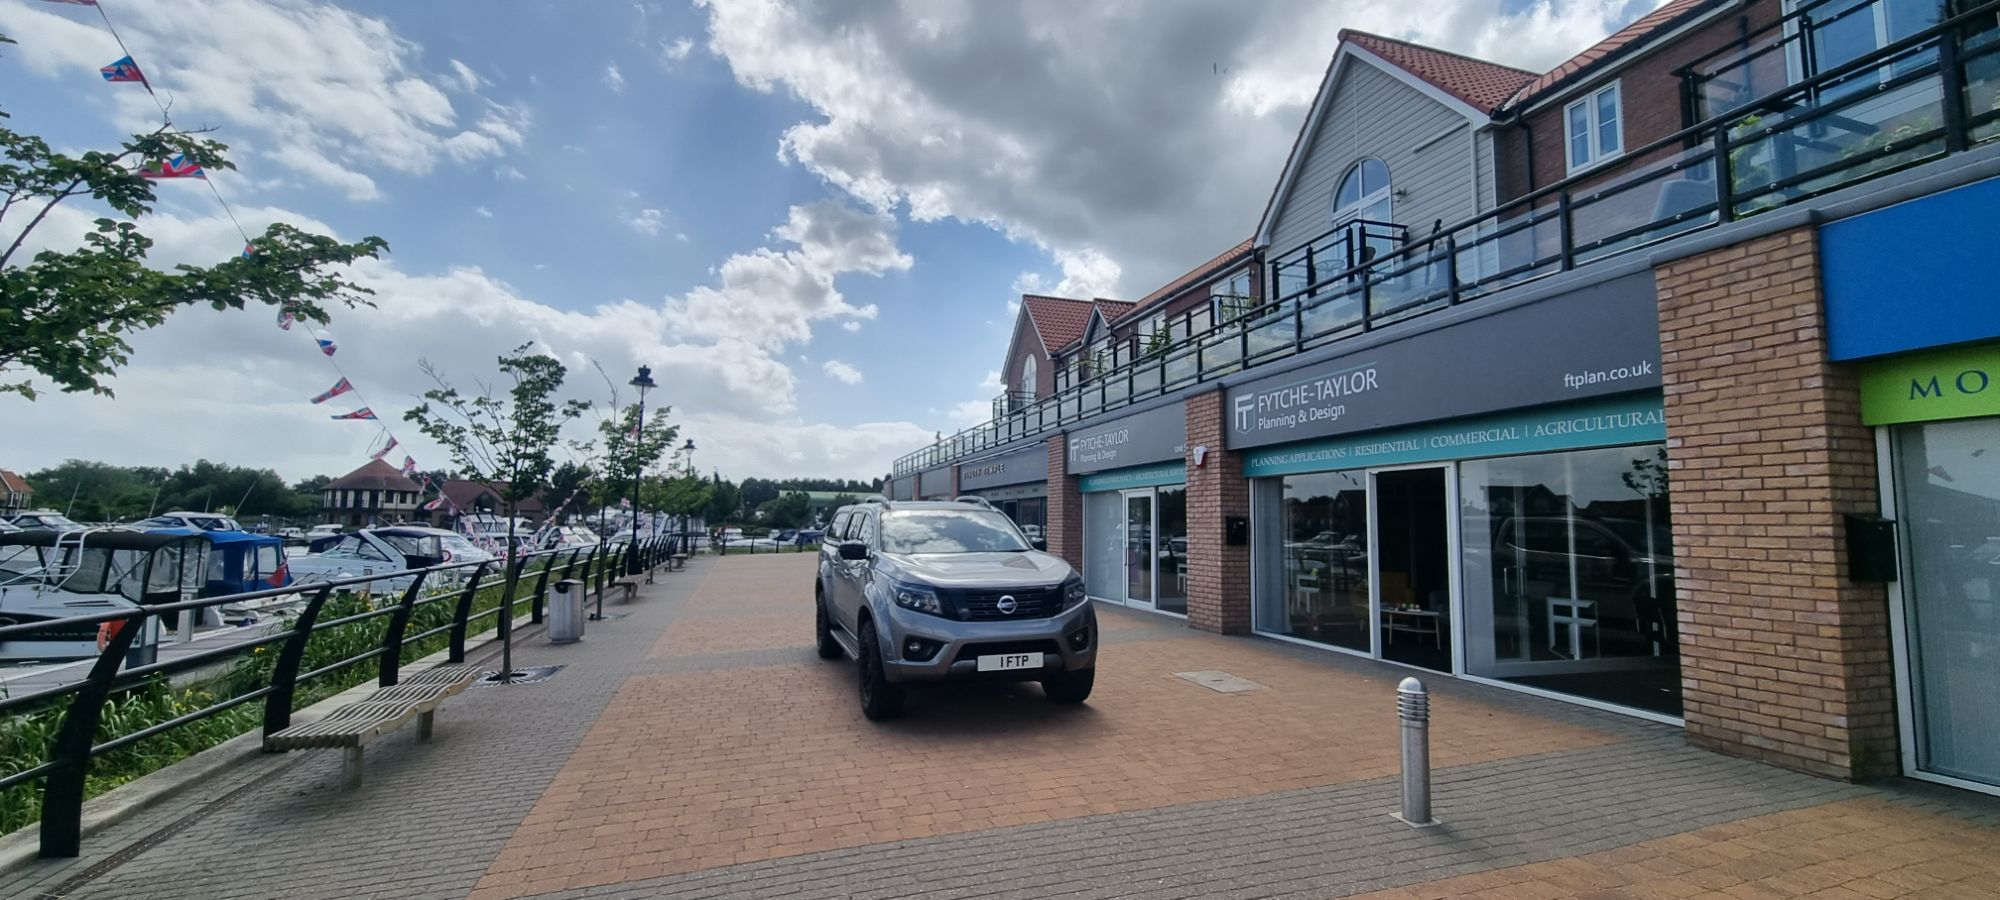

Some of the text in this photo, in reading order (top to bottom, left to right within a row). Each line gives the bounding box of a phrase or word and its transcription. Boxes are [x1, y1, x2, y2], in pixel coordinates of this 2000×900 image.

[1564, 360, 1652, 390] ftplan.co.uk
[1258, 368, 1379, 414] FYTCHE-TAYLOR
[1258, 403, 1345, 431] Planning & Design
[1080, 429, 1128, 451] FYTCHE-TAYLOR
[1290, 447, 1347, 464] APPLICATIONS
[1354, 438, 1420, 457] RESIDENTIAL
[1430, 425, 1520, 450] COMMERCIAL
[1533, 408, 1666, 437] AGRICULTURAL
